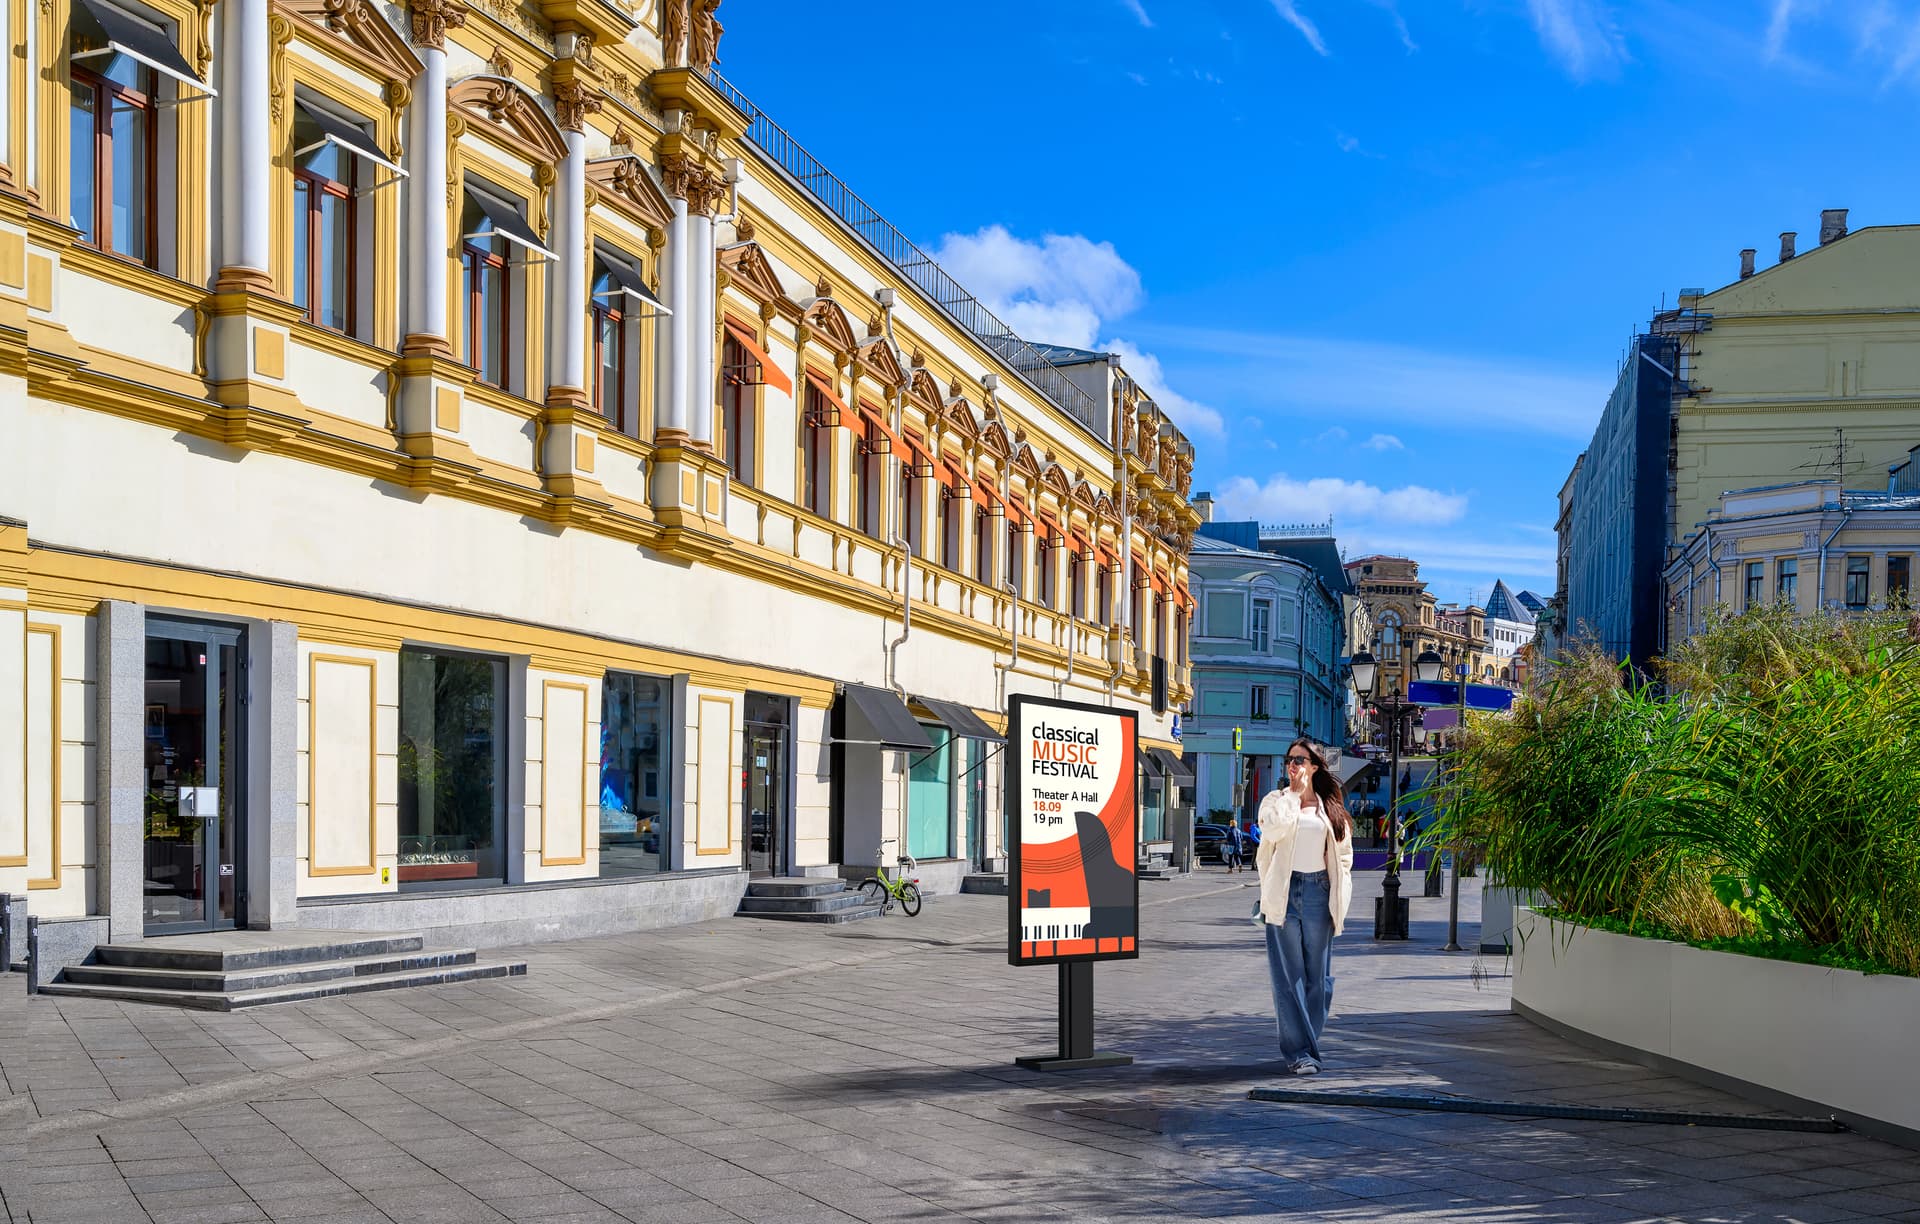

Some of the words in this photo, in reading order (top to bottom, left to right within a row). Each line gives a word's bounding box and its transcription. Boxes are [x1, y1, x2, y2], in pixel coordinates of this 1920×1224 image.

[1032, 721, 1099, 745] classical
[1033, 740, 1097, 764] MUSIC
[1032, 760, 1098, 779] FESTIVAL
[1032, 788, 1069, 800] Theater
[1071, 791, 1079, 801] A
[1081, 792, 1098, 802] Hall
[1033, 801, 1061, 812] 18.09
[1033, 813, 1045, 824] 19
[1048, 816, 1063, 827] pm
